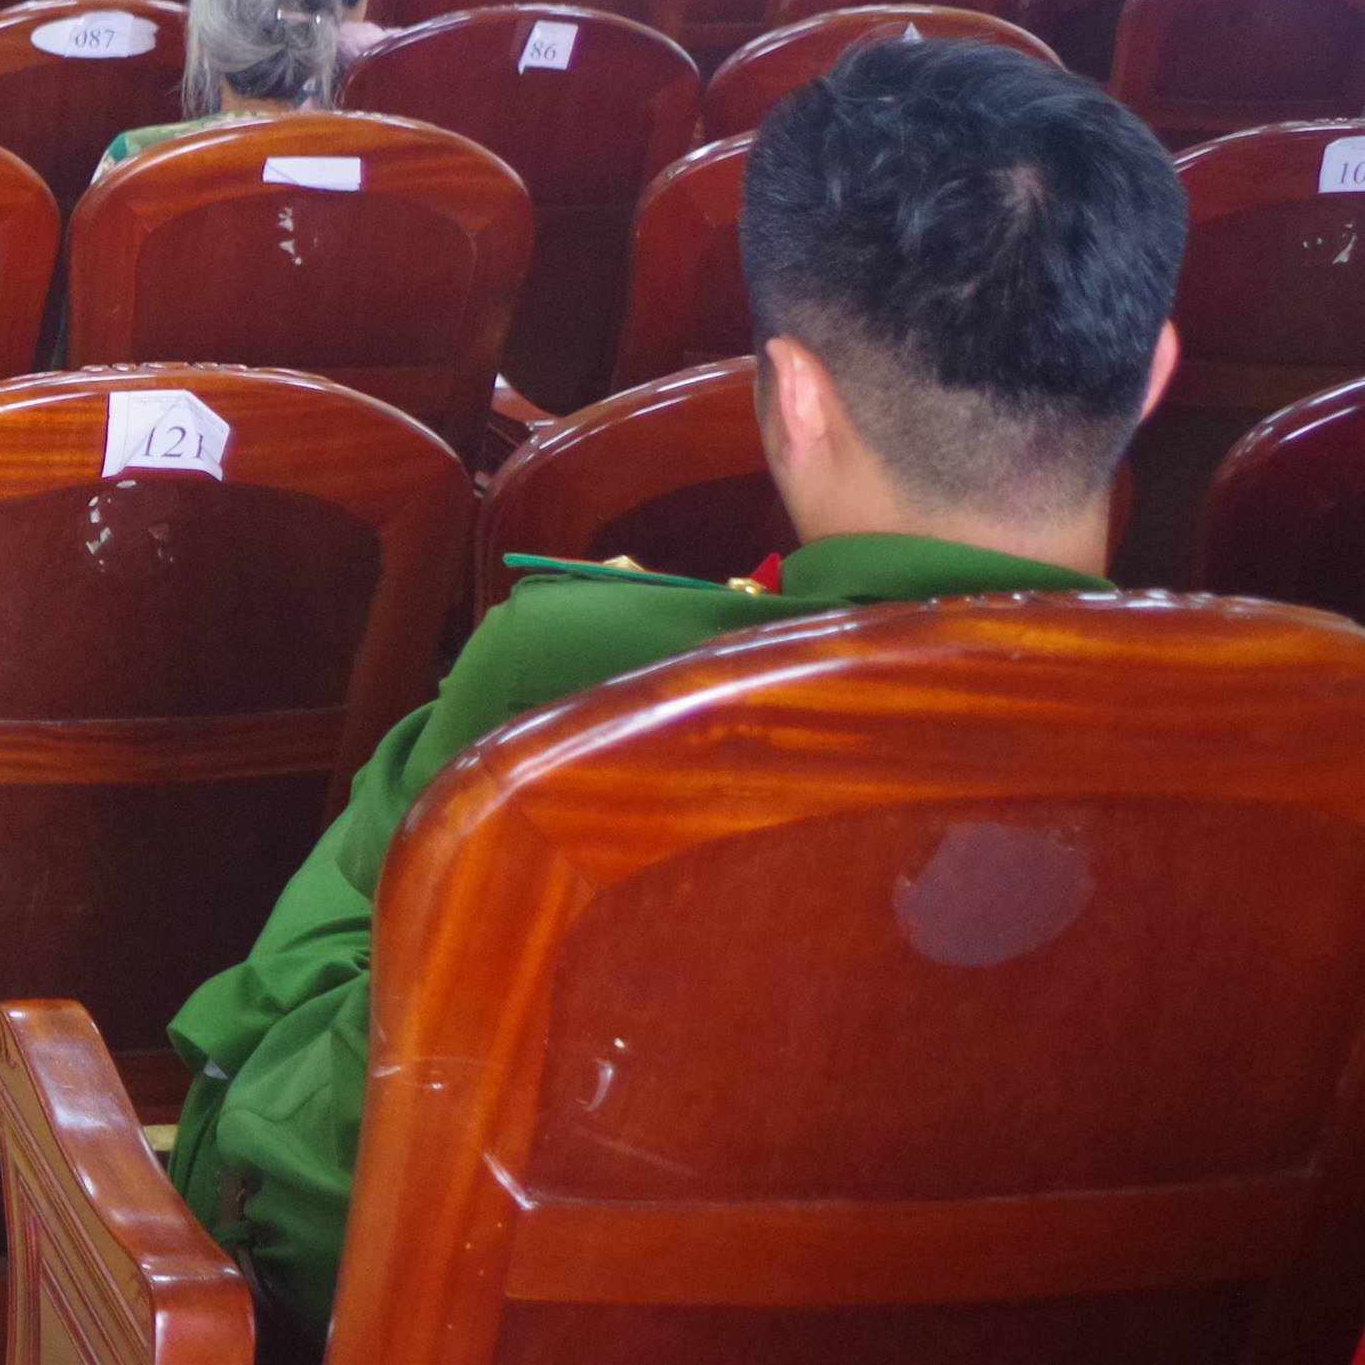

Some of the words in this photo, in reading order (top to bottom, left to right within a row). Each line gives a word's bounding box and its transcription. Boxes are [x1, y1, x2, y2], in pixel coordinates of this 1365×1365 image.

[75, 28, 116, 48] 087
[530, 41, 557, 60] 86
[142, 425, 204, 459] 121
